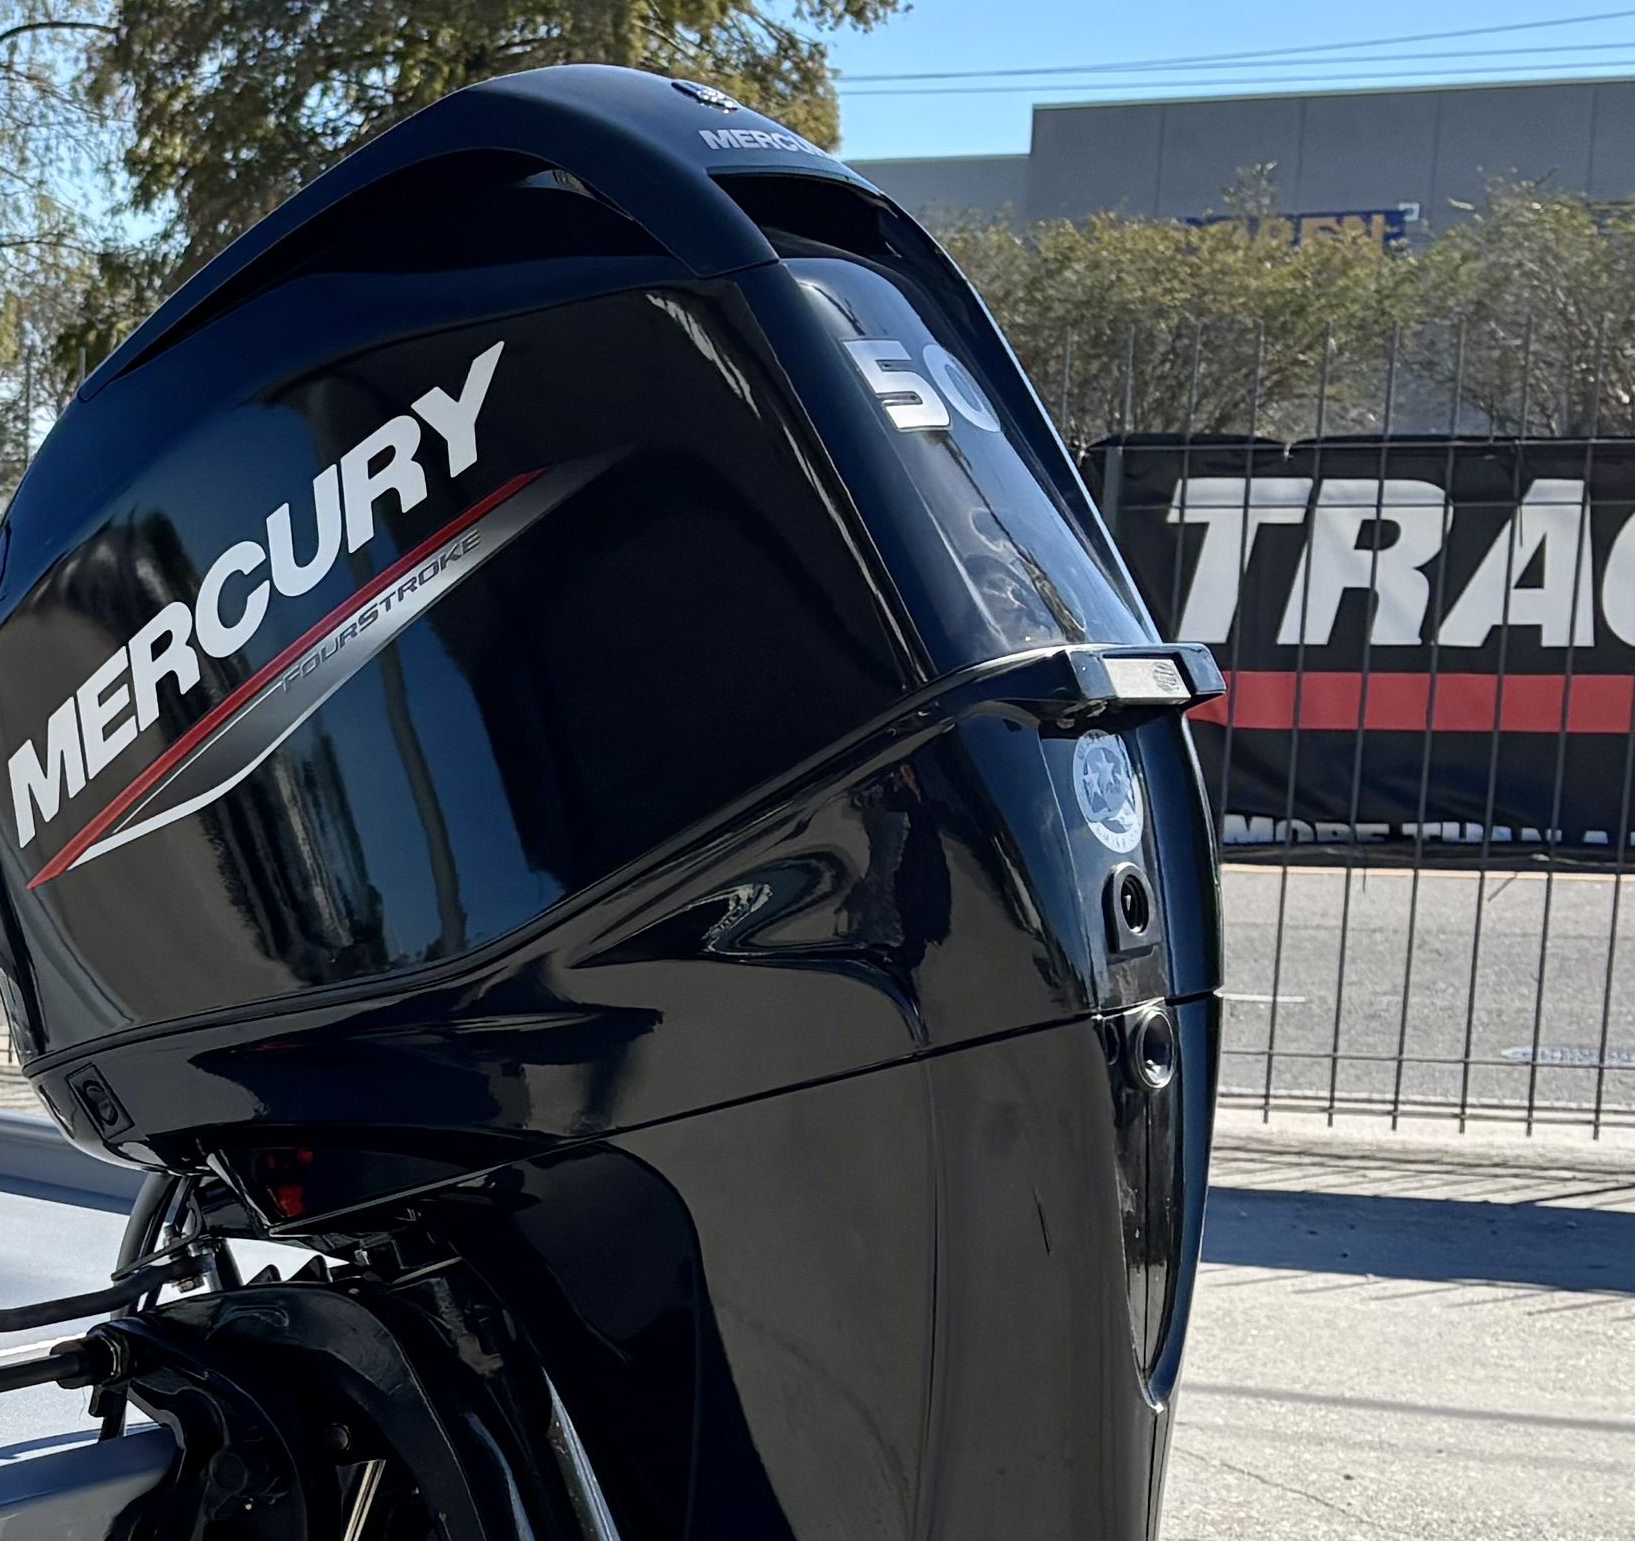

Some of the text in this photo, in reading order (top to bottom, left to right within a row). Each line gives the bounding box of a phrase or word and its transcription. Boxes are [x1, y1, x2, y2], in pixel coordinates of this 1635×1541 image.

[843, 340, 1001, 432] 50
[8, 340, 504, 848] MERCURY
[281, 529, 480, 692] FOURSTROKE
[1166, 477, 1635, 648] TRA
